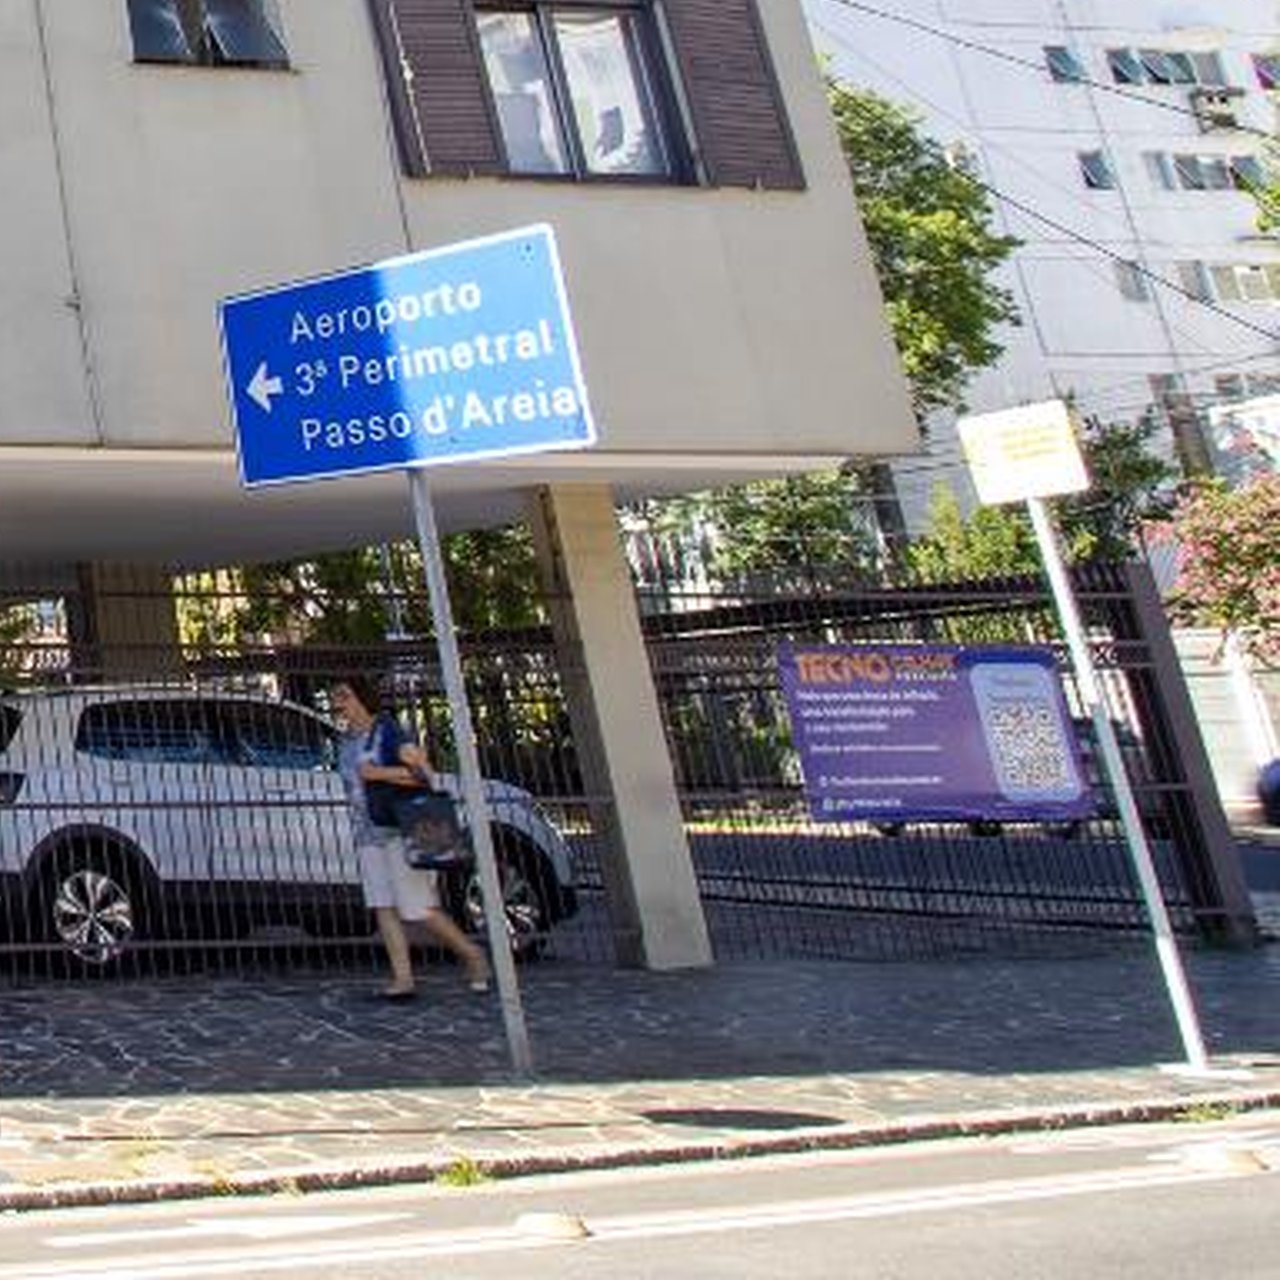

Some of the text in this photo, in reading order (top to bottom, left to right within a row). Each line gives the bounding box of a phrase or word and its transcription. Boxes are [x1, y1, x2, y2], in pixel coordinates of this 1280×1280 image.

[289, 280, 482, 344] Aeroporto
[340, 318, 555, 389] Perimetral
[301, 380, 580, 451] Passo d'Areia
[795, 652, 890, 684] TECNO
